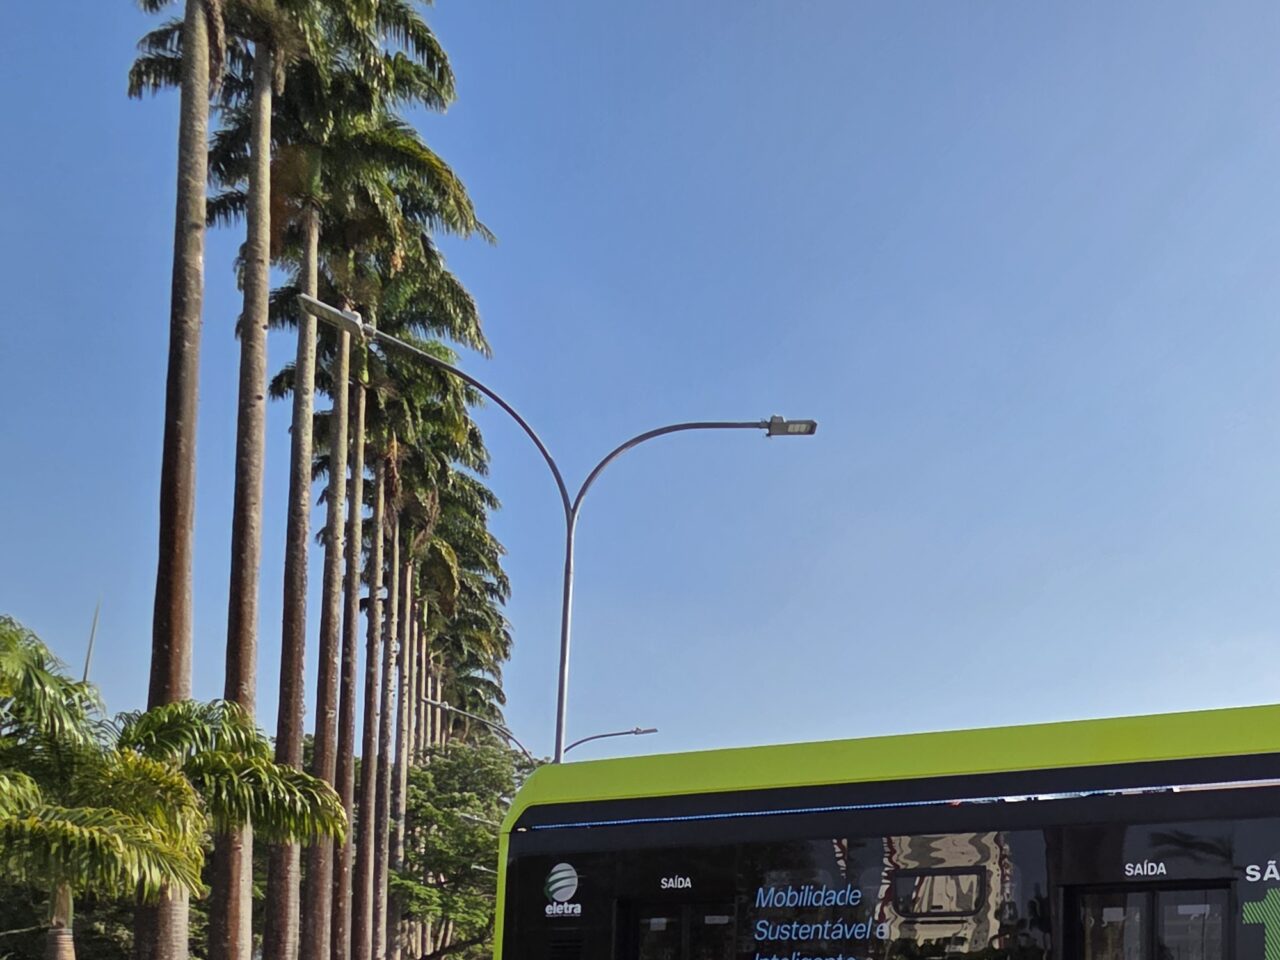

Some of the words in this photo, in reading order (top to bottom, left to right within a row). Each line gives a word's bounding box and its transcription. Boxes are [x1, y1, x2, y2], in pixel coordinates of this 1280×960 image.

[1124, 859, 1167, 876] SAÍDA
[660, 875, 692, 889] SAÍDA
[755, 884, 862, 908] Mobilidade
[545, 901, 582, 914] eletra
[754, 915, 873, 941] Sustentável
[876, 922, 890, 940] e
